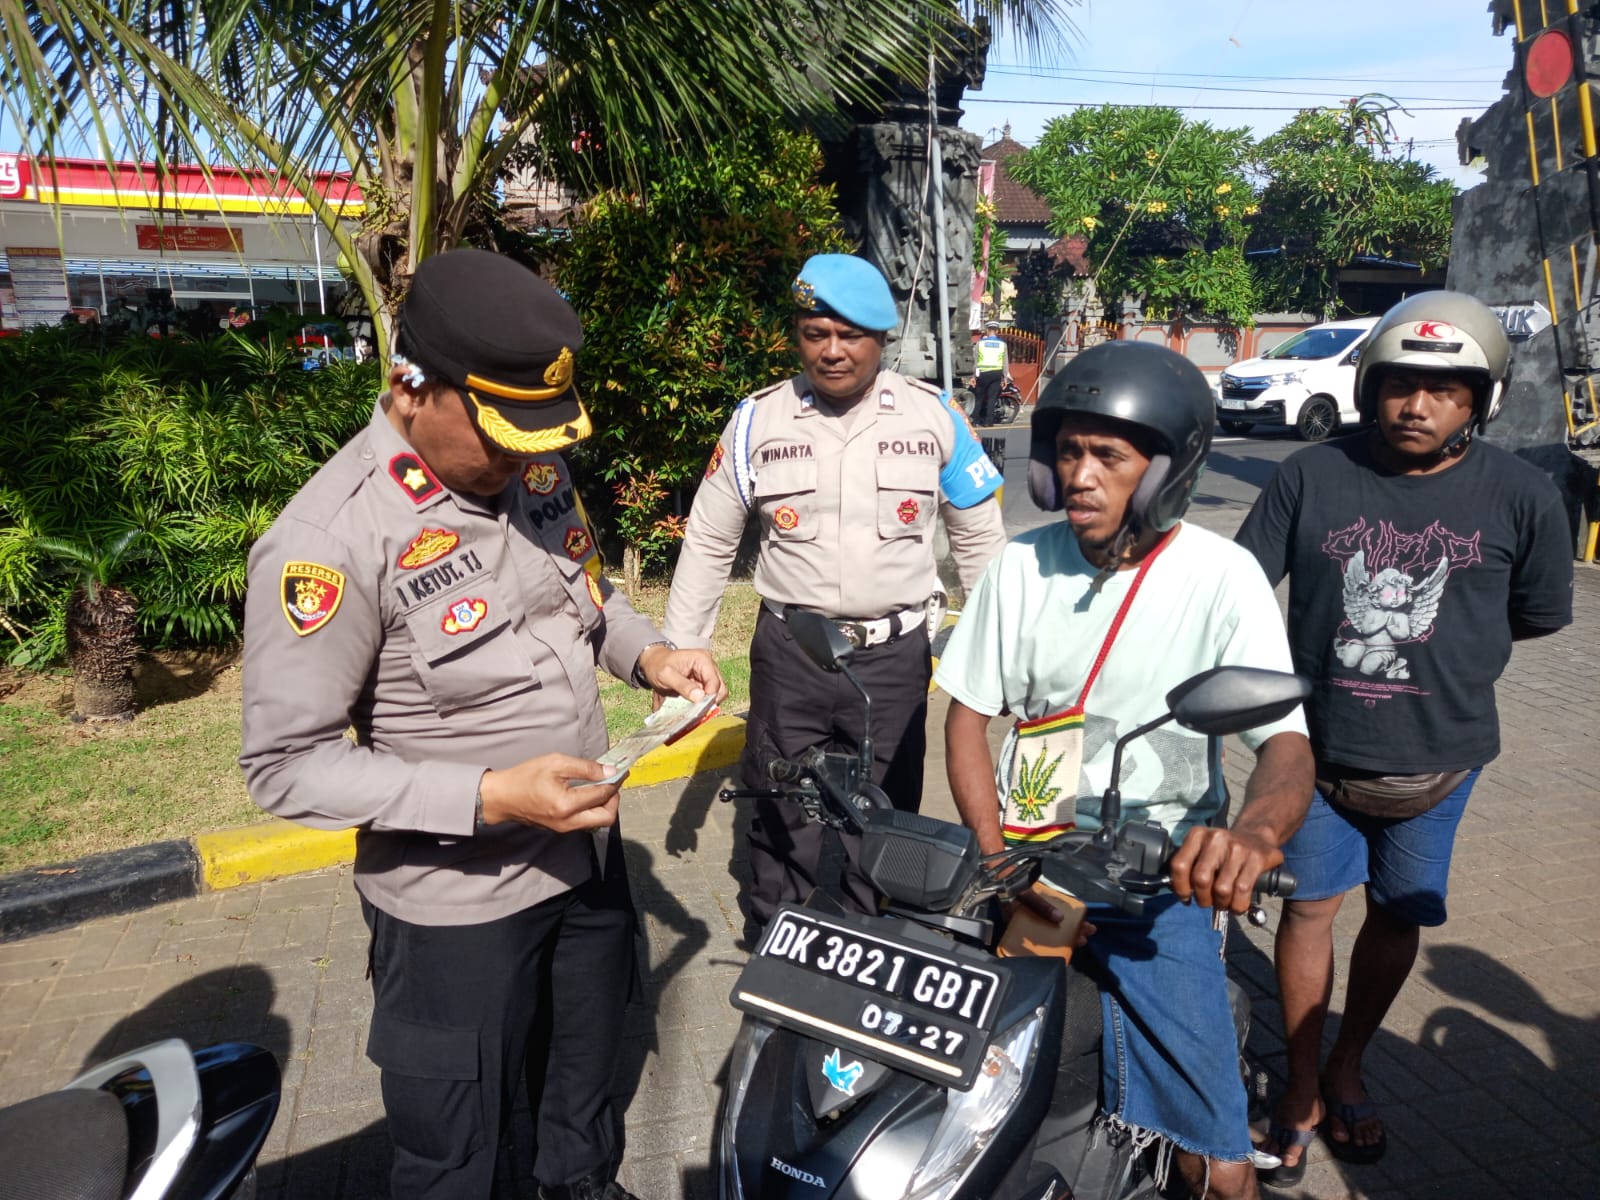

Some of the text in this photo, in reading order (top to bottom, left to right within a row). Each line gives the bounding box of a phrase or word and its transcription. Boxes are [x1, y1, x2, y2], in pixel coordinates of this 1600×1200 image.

[761, 444, 813, 465] WINARTA
[878, 441, 935, 457] POLRI
[459, 550, 482, 573] TJ
[289, 565, 339, 583] RESERSE
[769, 920, 819, 963] DK
[817, 936, 905, 992] 3821
[770, 1157, 826, 1189] HONDA
